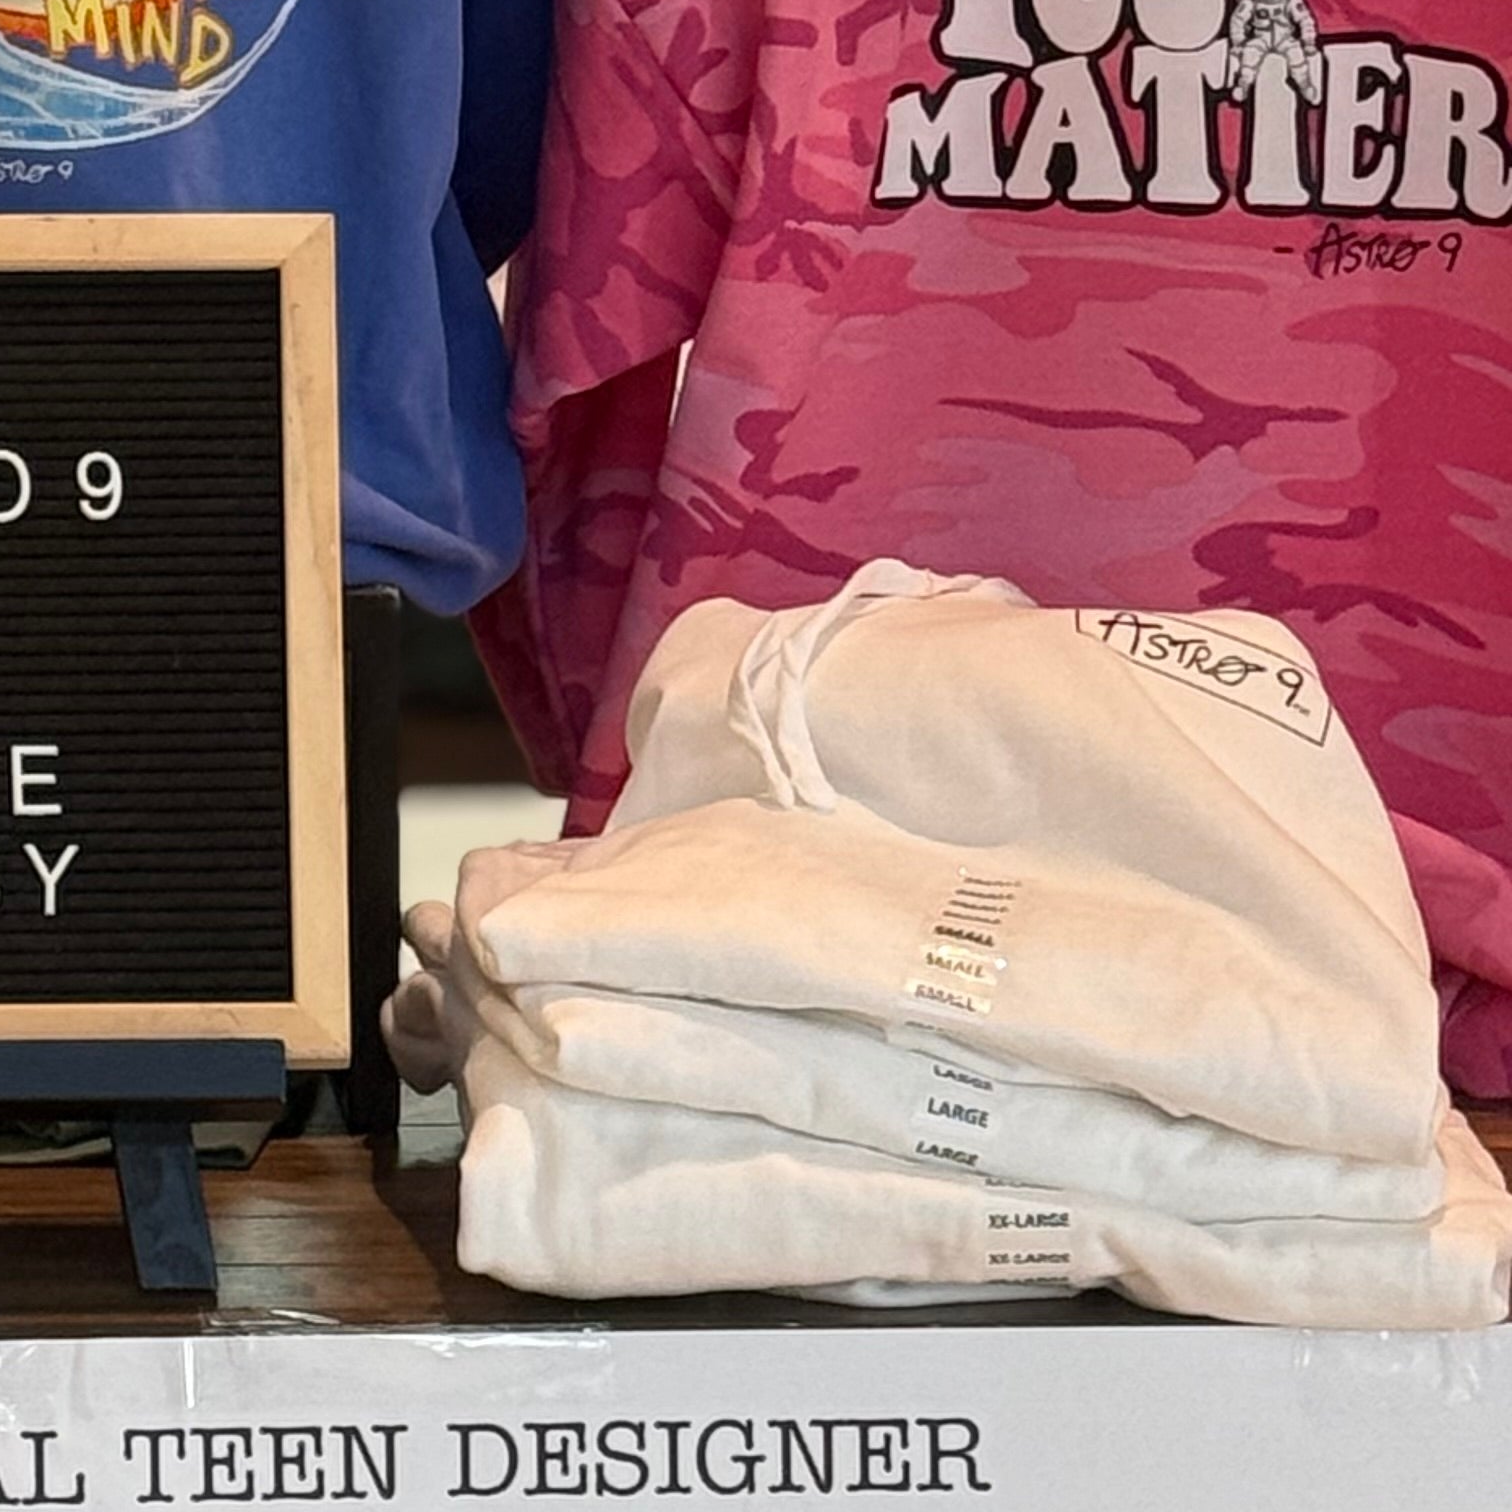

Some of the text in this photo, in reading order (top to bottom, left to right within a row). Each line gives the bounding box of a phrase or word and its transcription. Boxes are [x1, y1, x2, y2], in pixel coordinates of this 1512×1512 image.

[874, 36, 1512, 224] MATTER
[1437, 232, 1462, 272] 9
[76, 450, 123, 521] 9
[1276, 667, 1304, 708] 9
[927, 1097, 990, 1129] LARGE
[915, 1141, 979, 1166] LARGE
[988, 1212, 1070, 1229] XX-LARGE
[123, 1425, 408, 1504] TEEN
[446, 1418, 991, 1496] DESIGNER
